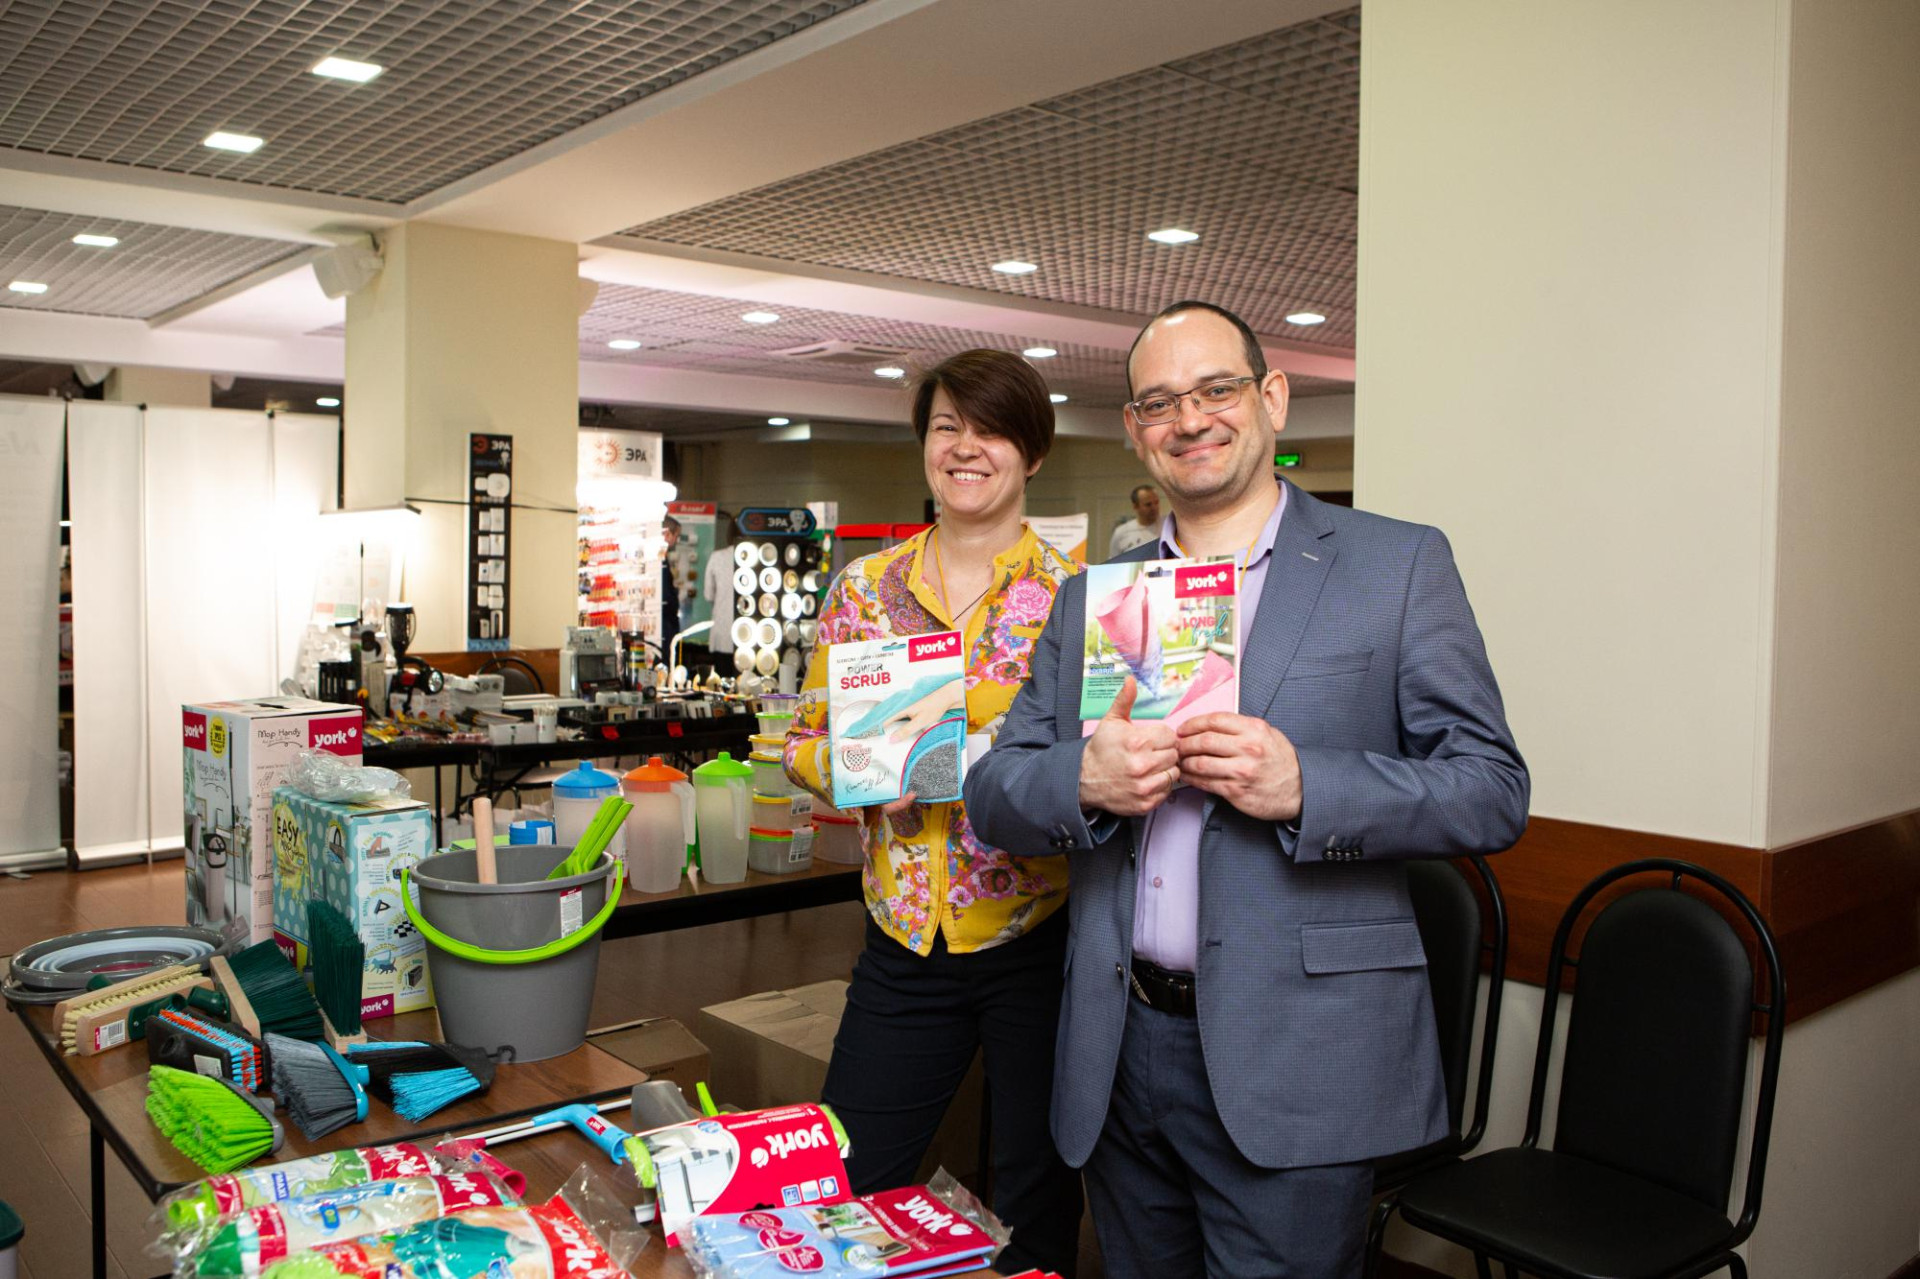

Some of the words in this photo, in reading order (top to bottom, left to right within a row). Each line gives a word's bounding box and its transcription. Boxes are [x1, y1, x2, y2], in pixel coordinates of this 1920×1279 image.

[491, 440, 511, 450] ЭРА
[625, 448, 647, 463] ЭРА
[767, 517, 788, 527] ЭРА
[1186, 574, 1218, 590] york
[1183, 616, 1216, 629] LONG
[915, 639, 947, 657] york
[847, 663, 884, 675] POWER
[840, 671, 892, 690] SCRUB
[184, 725, 200, 739] york
[279, 728, 301, 738] Handy
[314, 730, 348, 750] york
[276, 816, 299, 846] EASY
[361, 1003, 382, 1015] york
[765, 1123, 829, 1159] york
[894, 1195, 953, 1235] york
